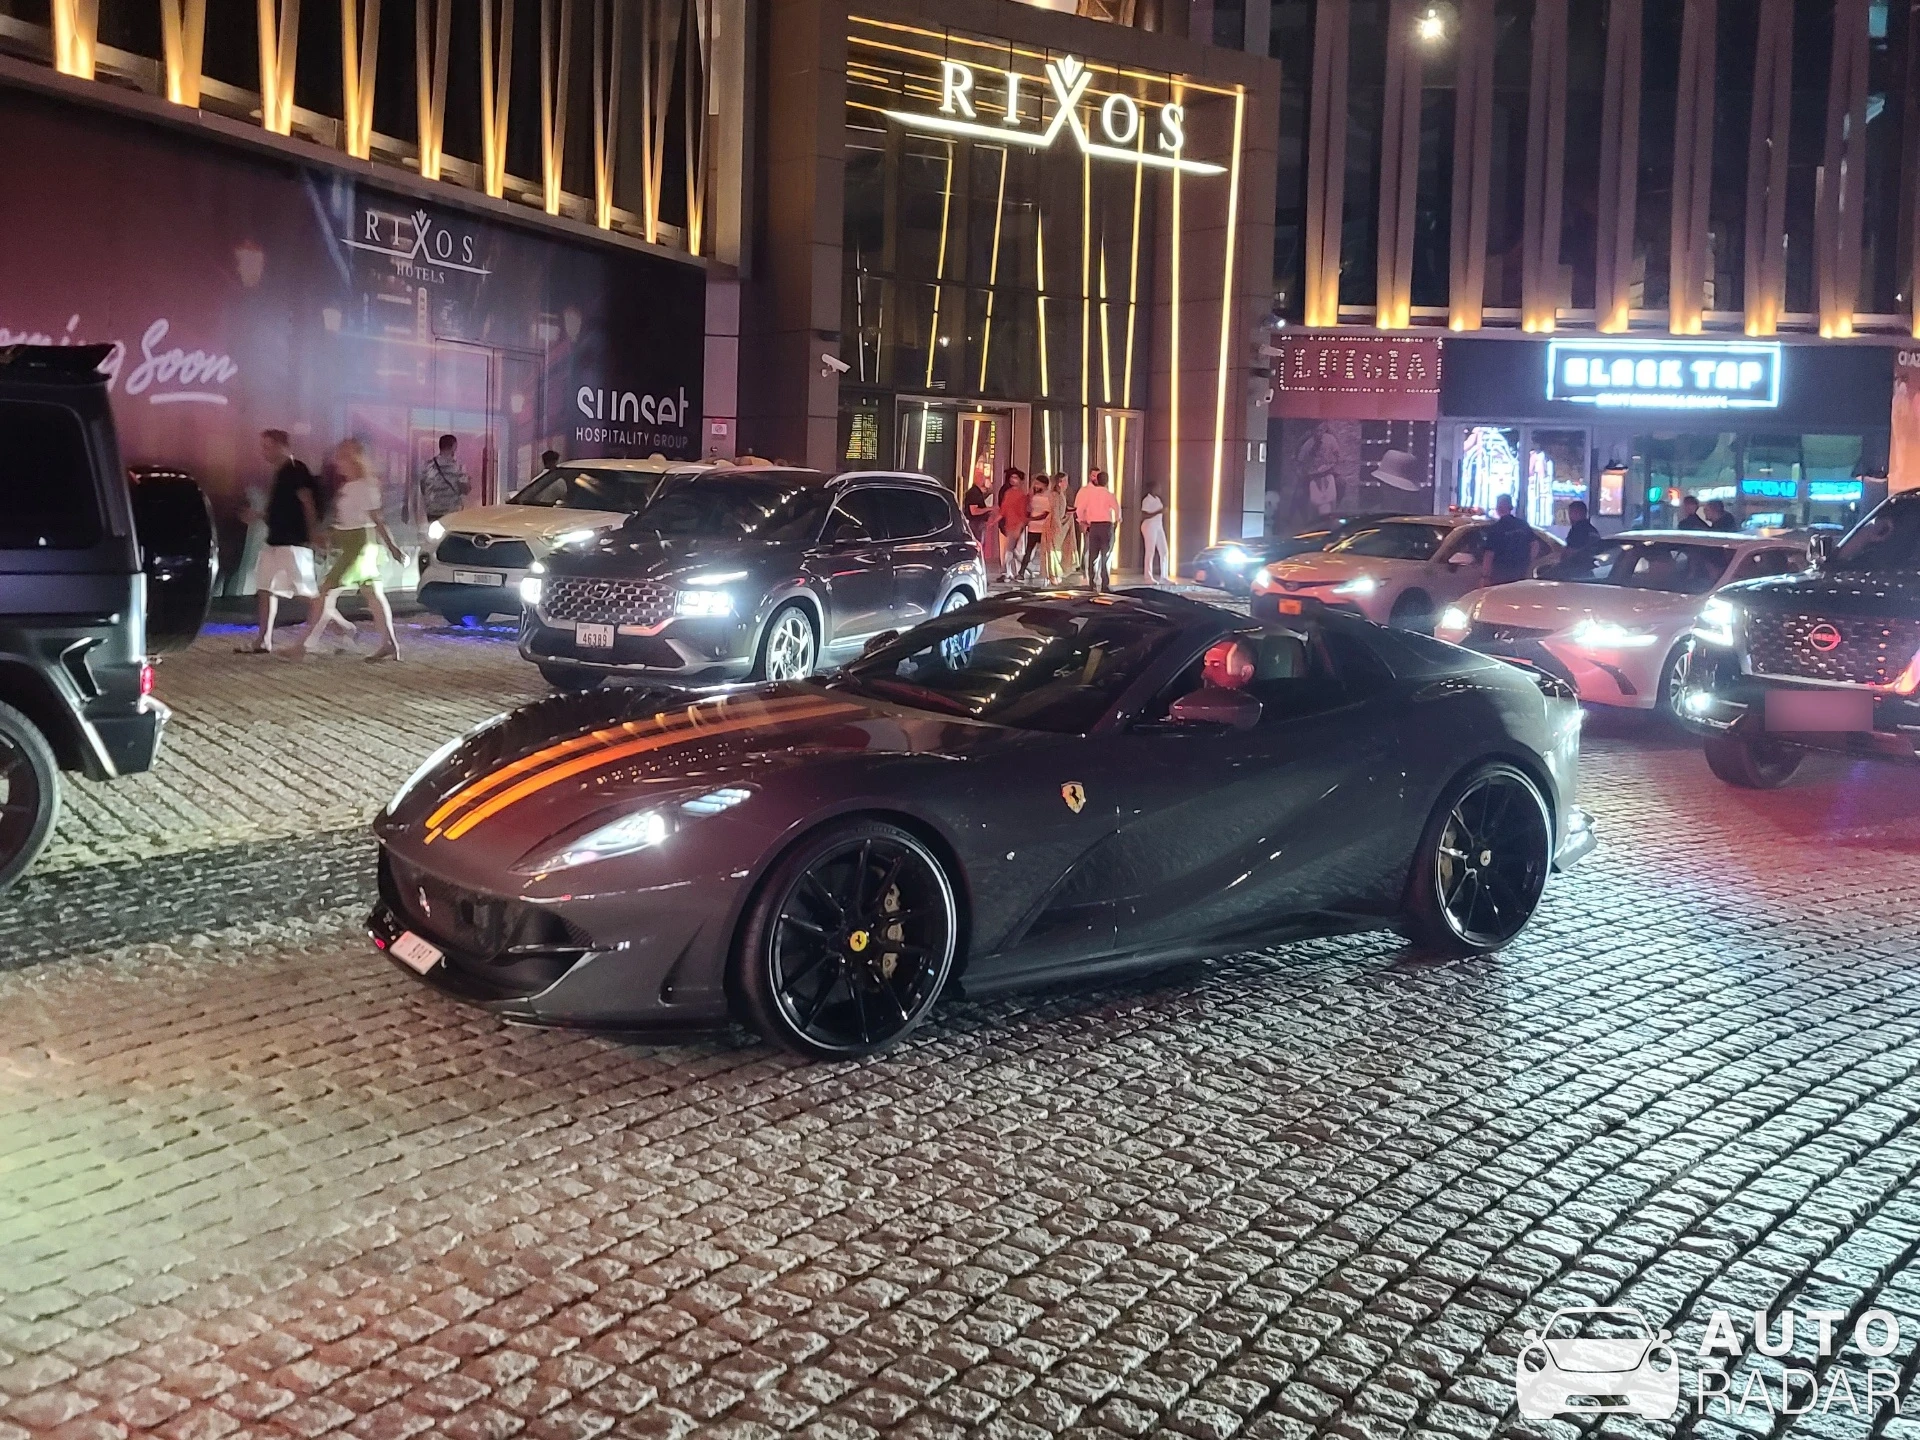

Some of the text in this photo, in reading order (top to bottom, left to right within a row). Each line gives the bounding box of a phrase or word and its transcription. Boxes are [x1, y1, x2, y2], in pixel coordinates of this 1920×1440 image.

[939, 56, 1186, 151] RIXOS
[365, 209, 473, 264] RIXOS
[396, 263, 446, 285] HOTELS
[125, 317, 239, 395] Soon
[1690, 359, 1763, 389] TAP
[576, 427, 689, 449] HOSPITALITY GROUP
